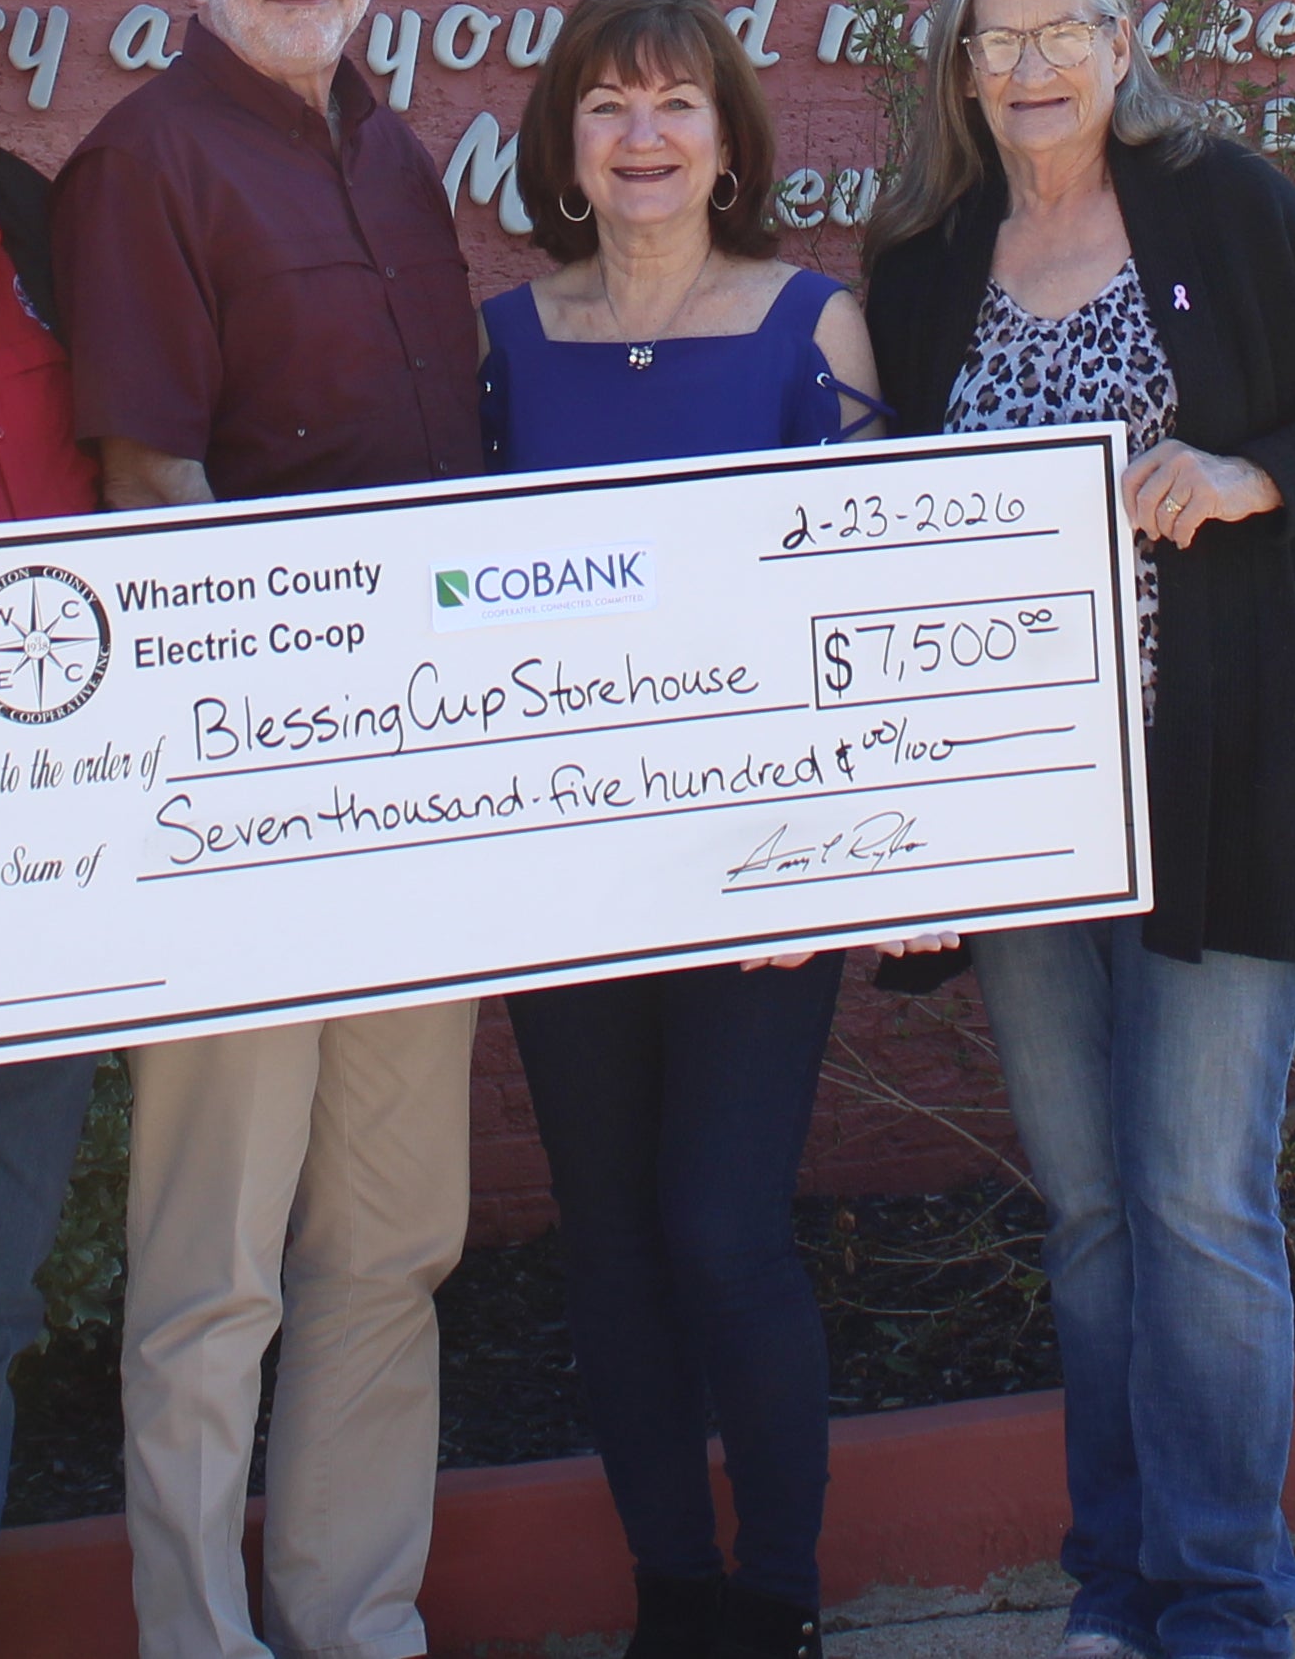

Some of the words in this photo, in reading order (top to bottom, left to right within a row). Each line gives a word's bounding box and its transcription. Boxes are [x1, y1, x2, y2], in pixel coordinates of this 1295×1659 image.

[366, 4, 564, 112] you
[782, 493, 1025, 550] 2-23-2026
[42, 566, 97, 605] COUNTY
[116, 574, 256, 613] Wharton
[267, 559, 382, 597] County
[134, 631, 258, 669] Electric
[268, 622, 366, 654] Co-op
[193, 693, 405, 761] Blessing
[407, 661, 507, 733] Cup
[511, 653, 761, 718] Storehouse
[0, 752, 21, 793] to
[30, 748, 66, 790] the
[72, 741, 133, 786] order
[139, 735, 167, 792] of
[156, 793, 313, 866] Seven
[641, 744, 825, 800] hundred
[0, 845, 66, 887] Sum
[74, 843, 108, 889] of
